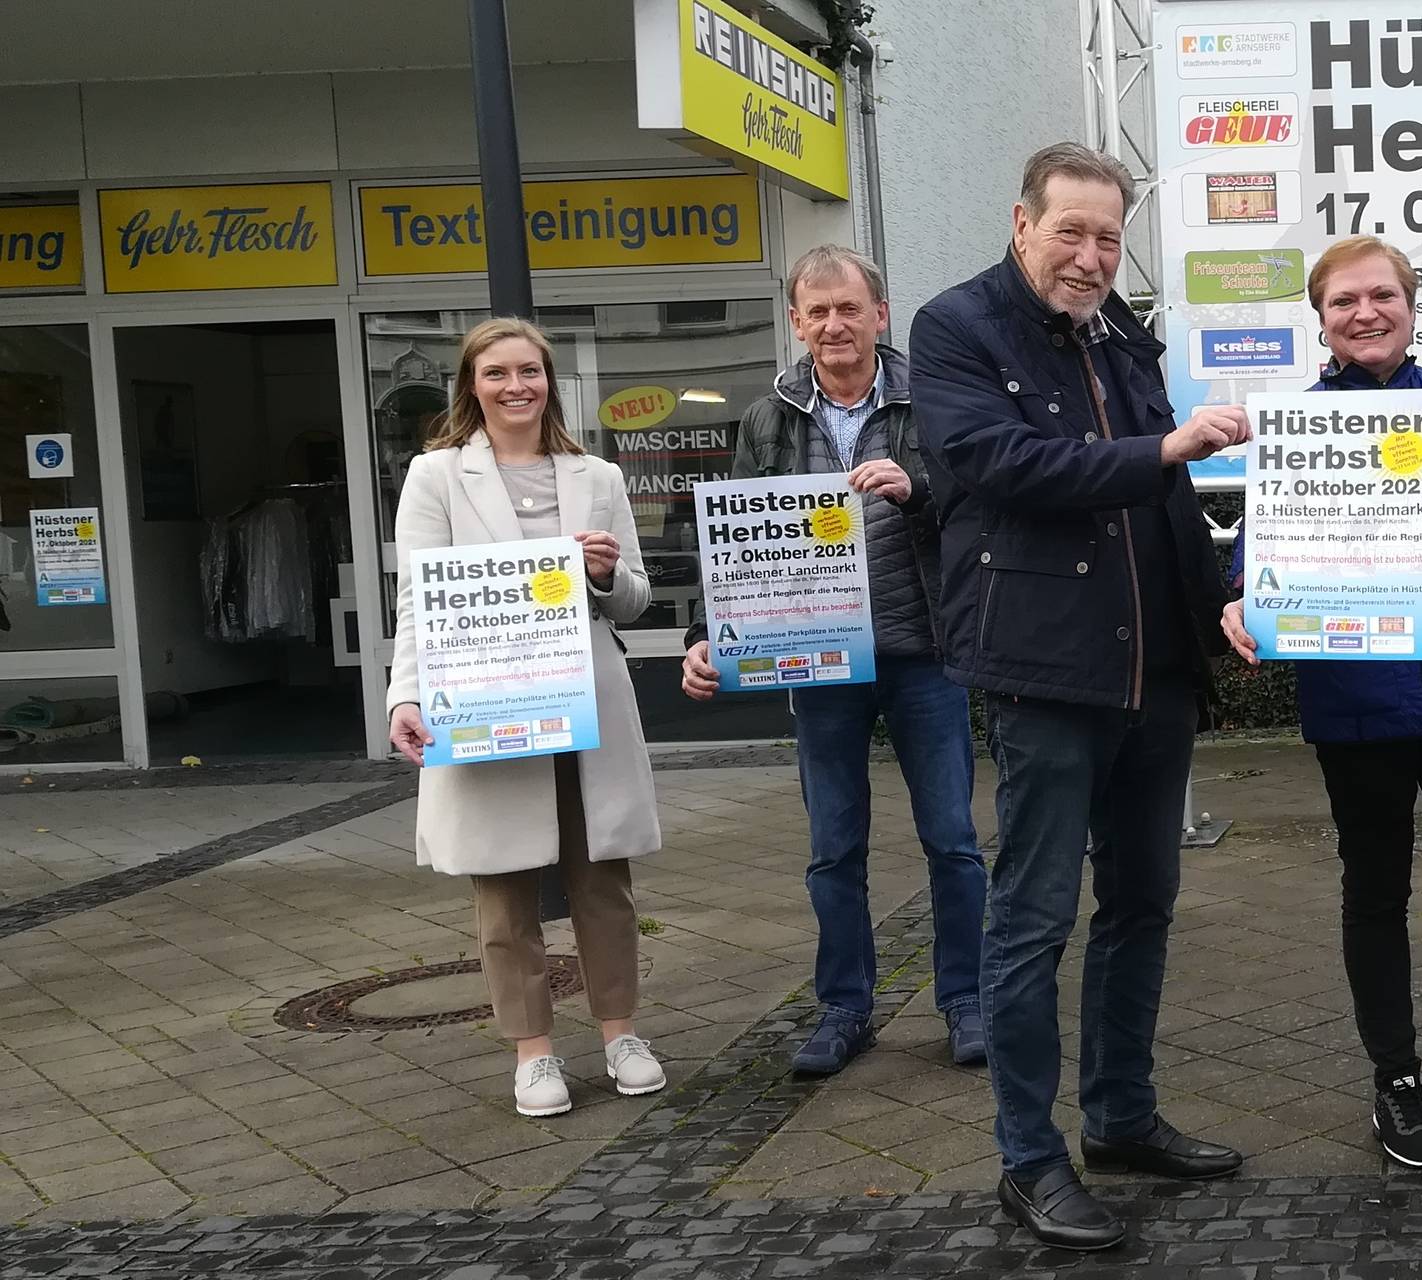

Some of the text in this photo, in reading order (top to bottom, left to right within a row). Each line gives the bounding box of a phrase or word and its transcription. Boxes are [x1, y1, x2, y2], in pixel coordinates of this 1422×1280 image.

[1236, 33, 1289, 42] STADTWERKE
[1236, 43, 1280, 51] ARNSBERG
[694, 1, 835, 125] REINSHOP
[1199, 101, 1279, 112] FLEISCHEREI
[742, 92, 771, 148] Gebr.
[1208, 176, 1273, 186] WALTER
[382, 197, 739, 247] Texteinigung
[1316, 192, 1385, 235] 17.
[117, 205, 318, 270] Gebr. Flesch
[1194, 261, 1268, 275] Friseurteam
[1222, 275, 1268, 289] Schulte
[1214, 342, 1281, 352] KRESS
[609, 394, 665, 422] NEU!
[614, 429, 727, 451] WASCHEN
[1259, 445, 1382, 470] Herbst
[1259, 481, 1289, 496] 17.
[1294, 479, 1376, 496] Oktober
[706, 491, 849, 517] Hüstener
[1256, 505, 1269, 517] 8.
[1272, 504, 1343, 516] Hüstener
[35, 515, 93, 525] Hüstener
[36, 527, 79, 538] Herbst
[708, 518, 814, 545] Herbst
[711, 543, 856, 566] 17. Oktober 2021
[422, 555, 571, 583] Hüstener
[711, 563, 857, 583] 8. Hüstener Landmarkt
[424, 582, 533, 611] Herbst
[1255, 598, 1303, 609] VGH
[426, 606, 578, 632] 17. Oktober 2021
[426, 625, 578, 650] 8. Hüstener Landmarkt
[1287, 639, 1320, 648] VELTINS
[718, 645, 758, 656] VGH
[748, 675, 776, 683] VELTINS
[430, 713, 473, 726] VGH
[461, 744, 490, 754] VELTINS
